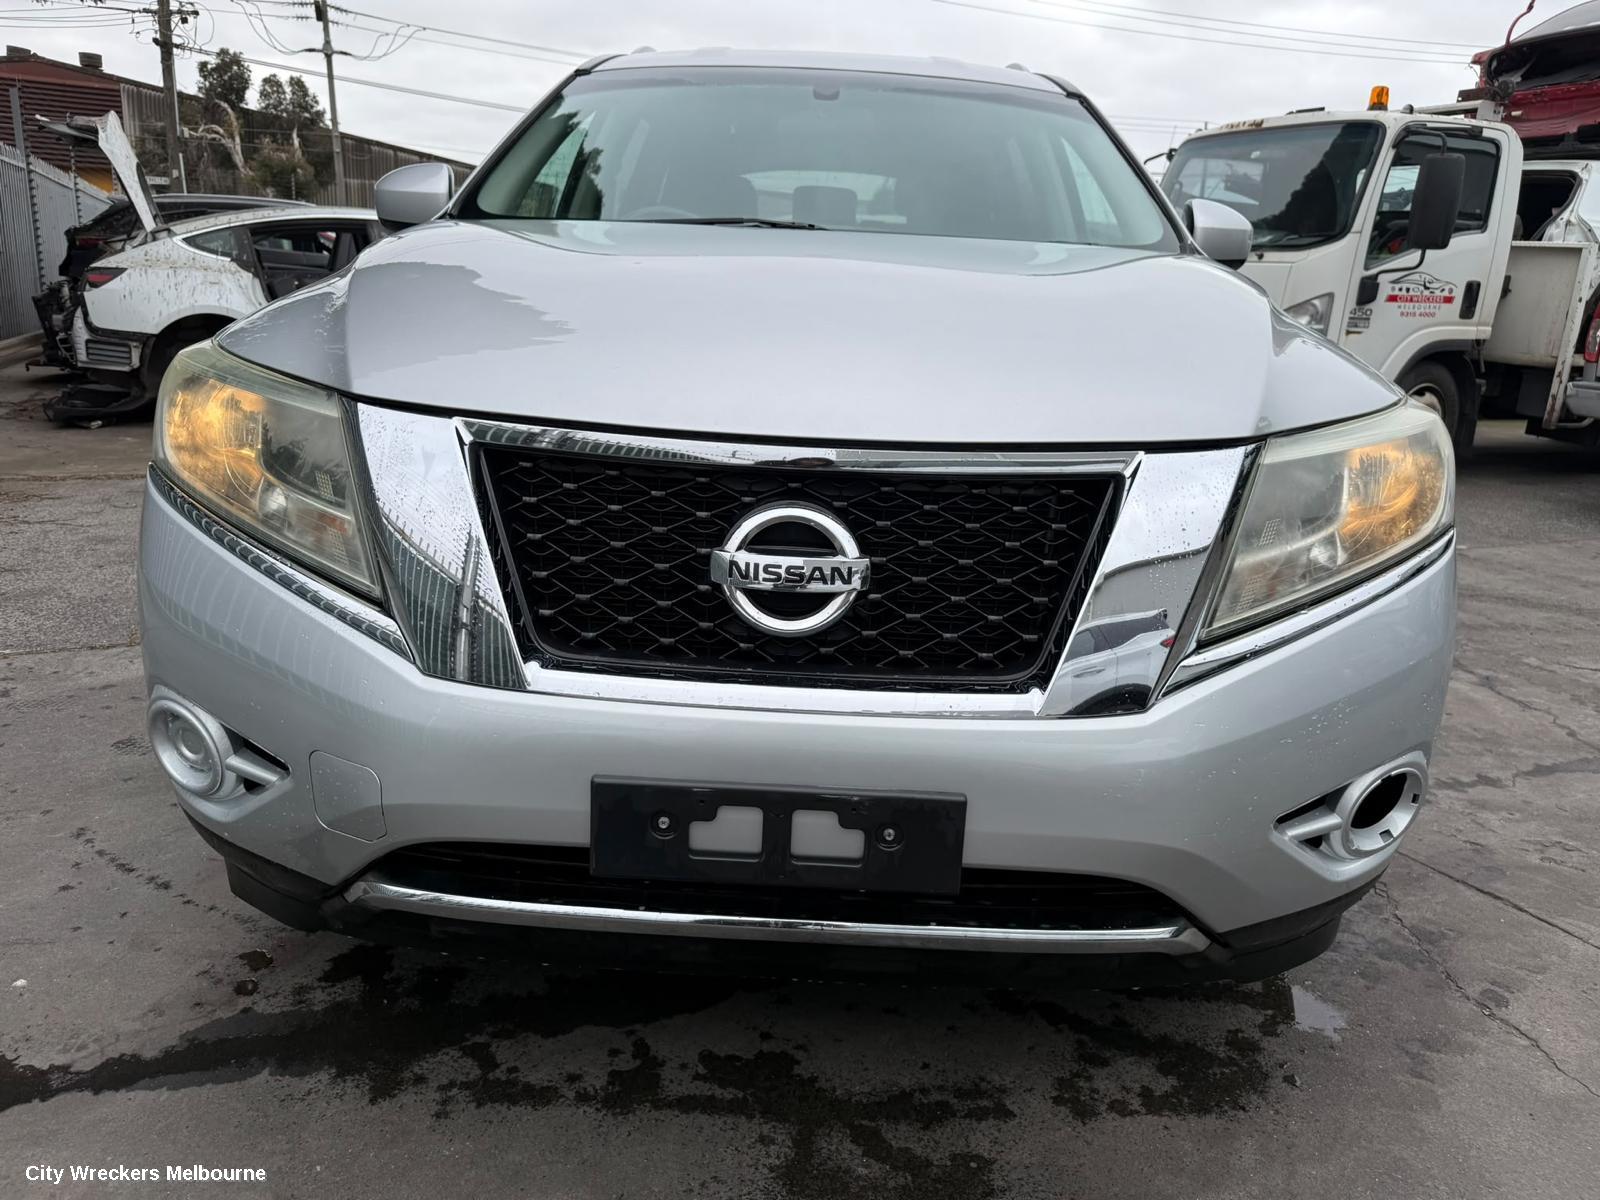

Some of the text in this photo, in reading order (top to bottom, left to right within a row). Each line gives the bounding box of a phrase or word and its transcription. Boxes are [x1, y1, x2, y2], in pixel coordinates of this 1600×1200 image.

[1396, 295, 1444, 304] CITY WRECKERS
[1349, 307, 1373, 317] 450
[728, 559, 853, 586] NISSAN
